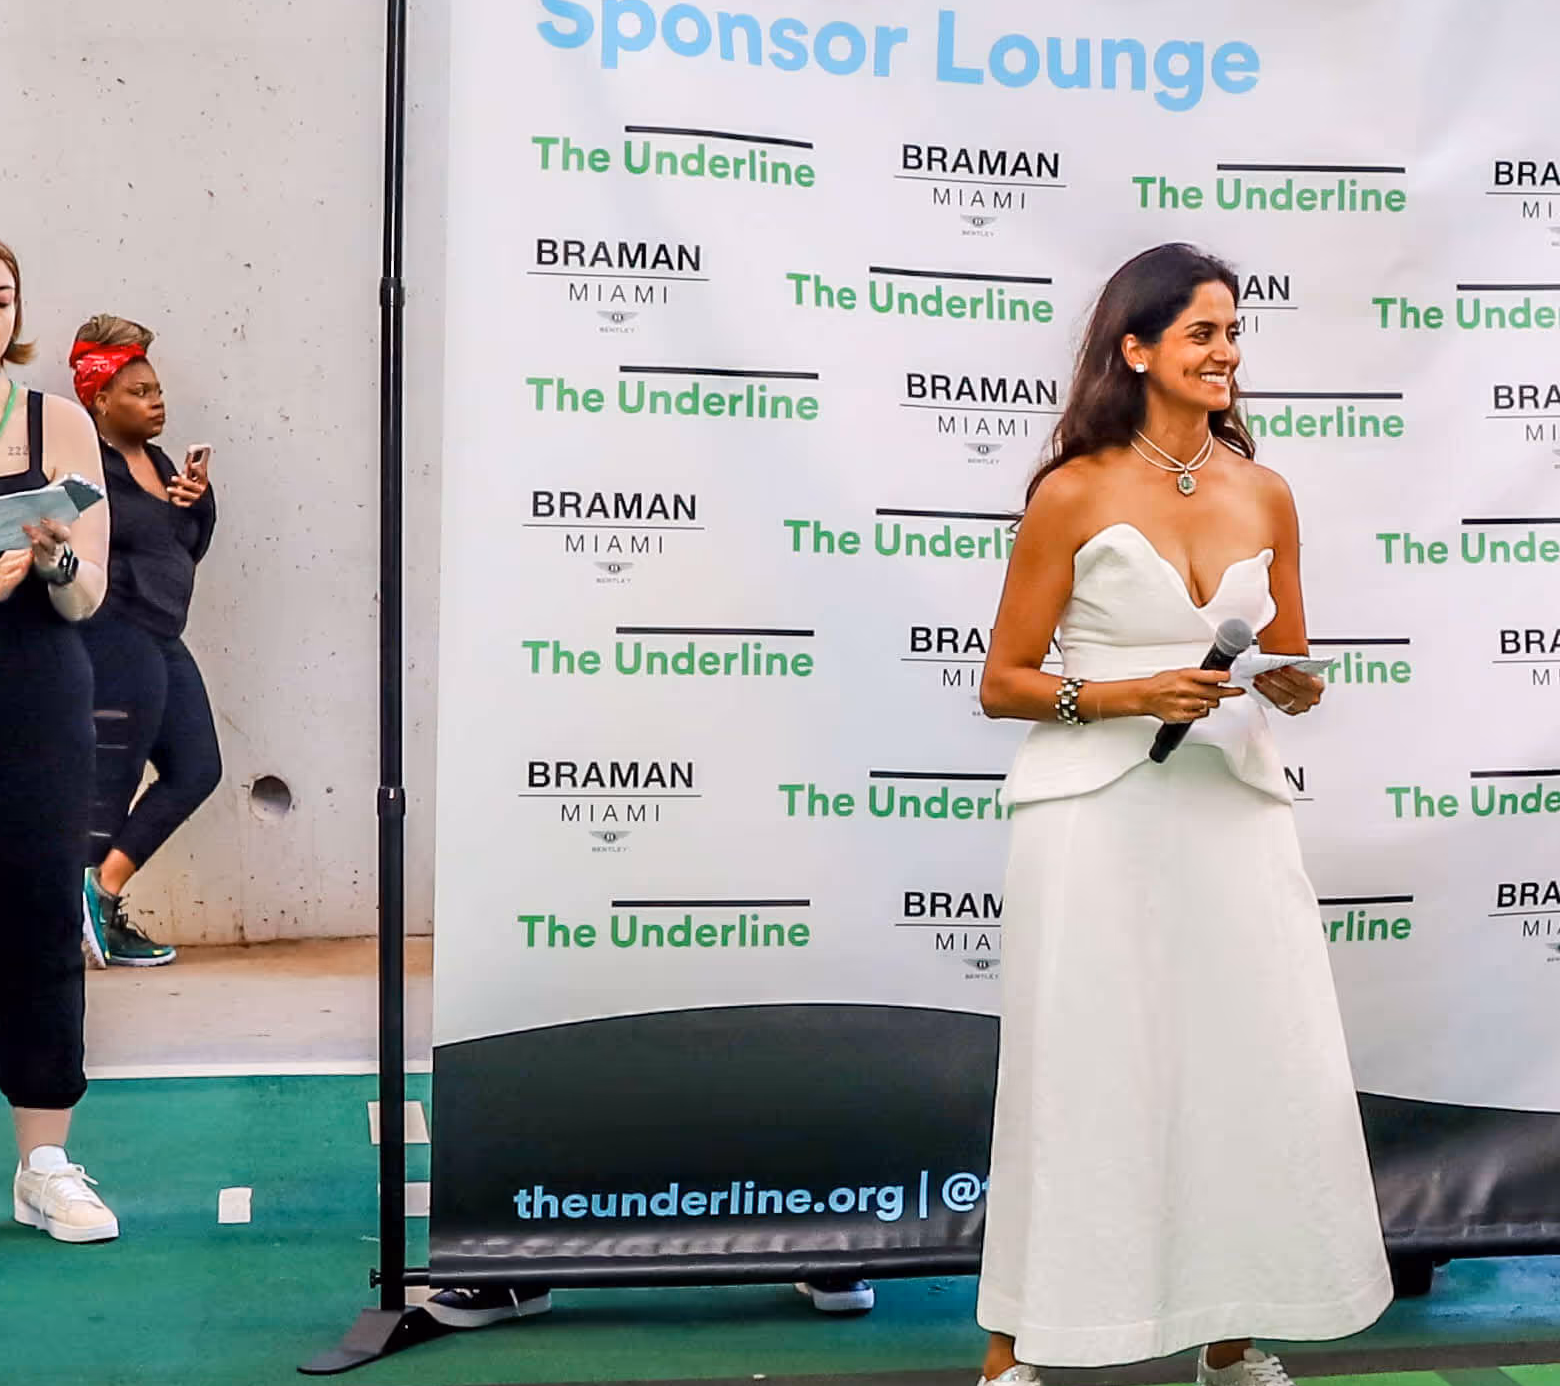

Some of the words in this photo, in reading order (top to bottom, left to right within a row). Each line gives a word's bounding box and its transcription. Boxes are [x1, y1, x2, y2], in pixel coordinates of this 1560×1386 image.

[937, 10, 1260, 112] Lounge
[532, 137, 610, 173] The
[625, 141, 815, 187] Underline
[903, 144, 1059, 179] BRAMAN
[934, 187, 1024, 209] MIAMI
[1132, 177, 1203, 208] The
[1218, 180, 1406, 211] Underline
[537, 239, 700, 271] BRAMAN
[570, 283, 667, 304] MIAMI
[787, 273, 856, 309] The
[870, 281, 1053, 322] Underline
[1373, 298, 1443, 328] The
[528, 378, 604, 413] The
[619, 381, 818, 420] Underline
[907, 373, 1057, 405] BRAMAN
[939, 416, 1027, 437] MIAMI
[1248, 407, 1403, 437] nderline
[533, 491, 696, 520] BRAMAN
[566, 534, 662, 554] MIAMI
[784, 519, 860, 554] The
[1378, 533, 1448, 563] The
[911, 627, 987, 653] BRA
[522, 640, 600, 675] The
[616, 643, 814, 676] Underline
[1329, 653, 1410, 683] rline
[528, 761, 693, 788] BRAMAN
[562, 805, 659, 822] MIAMI
[779, 784, 855, 816] The
[870, 785, 1014, 819] Underl
[1387, 787, 1458, 817] The
[904, 892, 1003, 918] BRAM
[518, 914, 596, 948] The
[612, 914, 810, 948] Underline
[1331, 911, 1412, 941] rline
[936, 933, 1002, 951] MIA
[514, 1181, 903, 1221] theunderline.org
